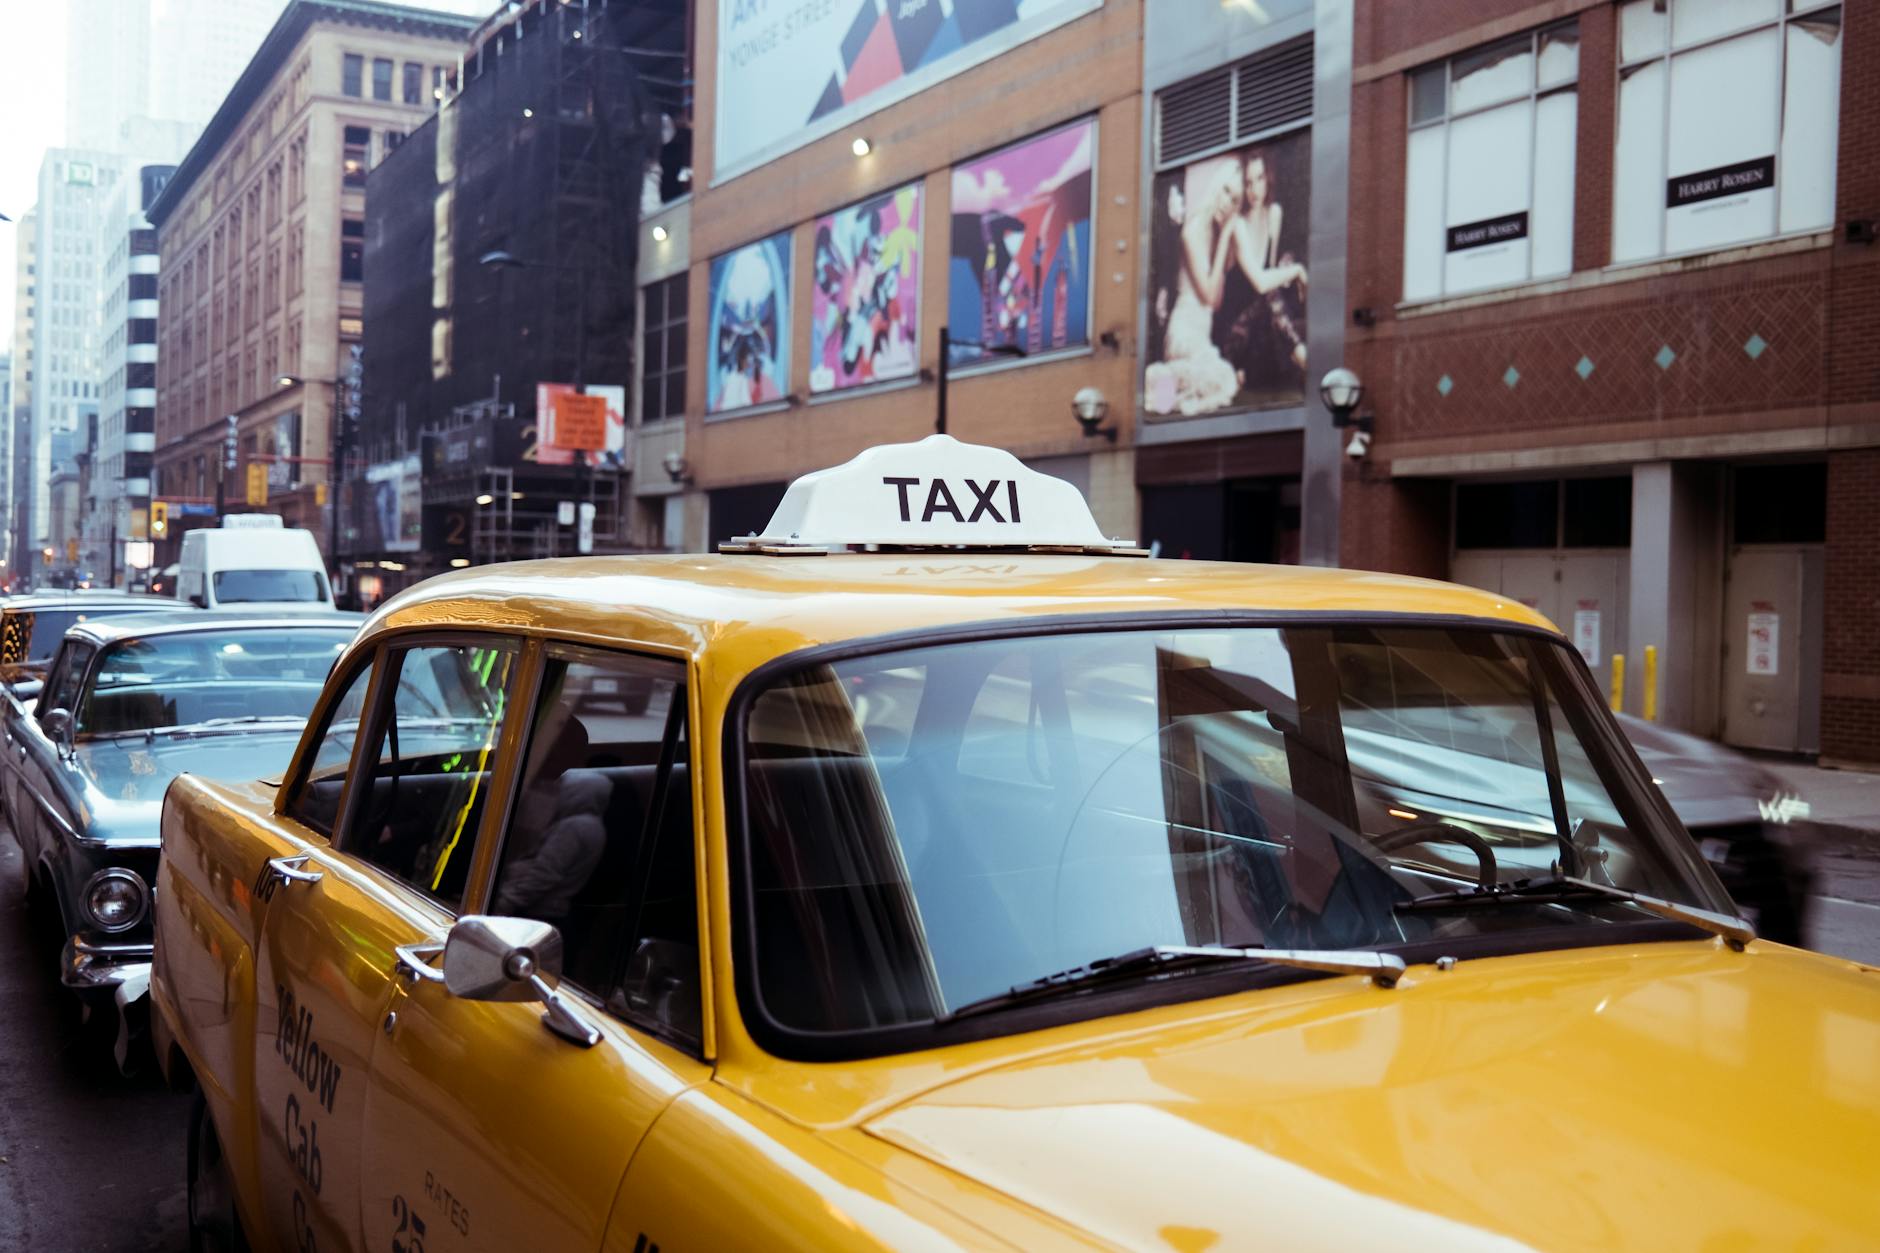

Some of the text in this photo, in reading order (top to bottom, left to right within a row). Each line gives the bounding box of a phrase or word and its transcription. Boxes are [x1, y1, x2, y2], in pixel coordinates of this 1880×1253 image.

[1678, 168, 1764, 198] HARRY ROSEN
[882, 476, 1021, 523] TAXI
[446, 512, 466, 545] 2
[275, 983, 341, 1114] Yellow
[285, 1092, 322, 1196] Cab
[424, 1170, 469, 1237] RATES
